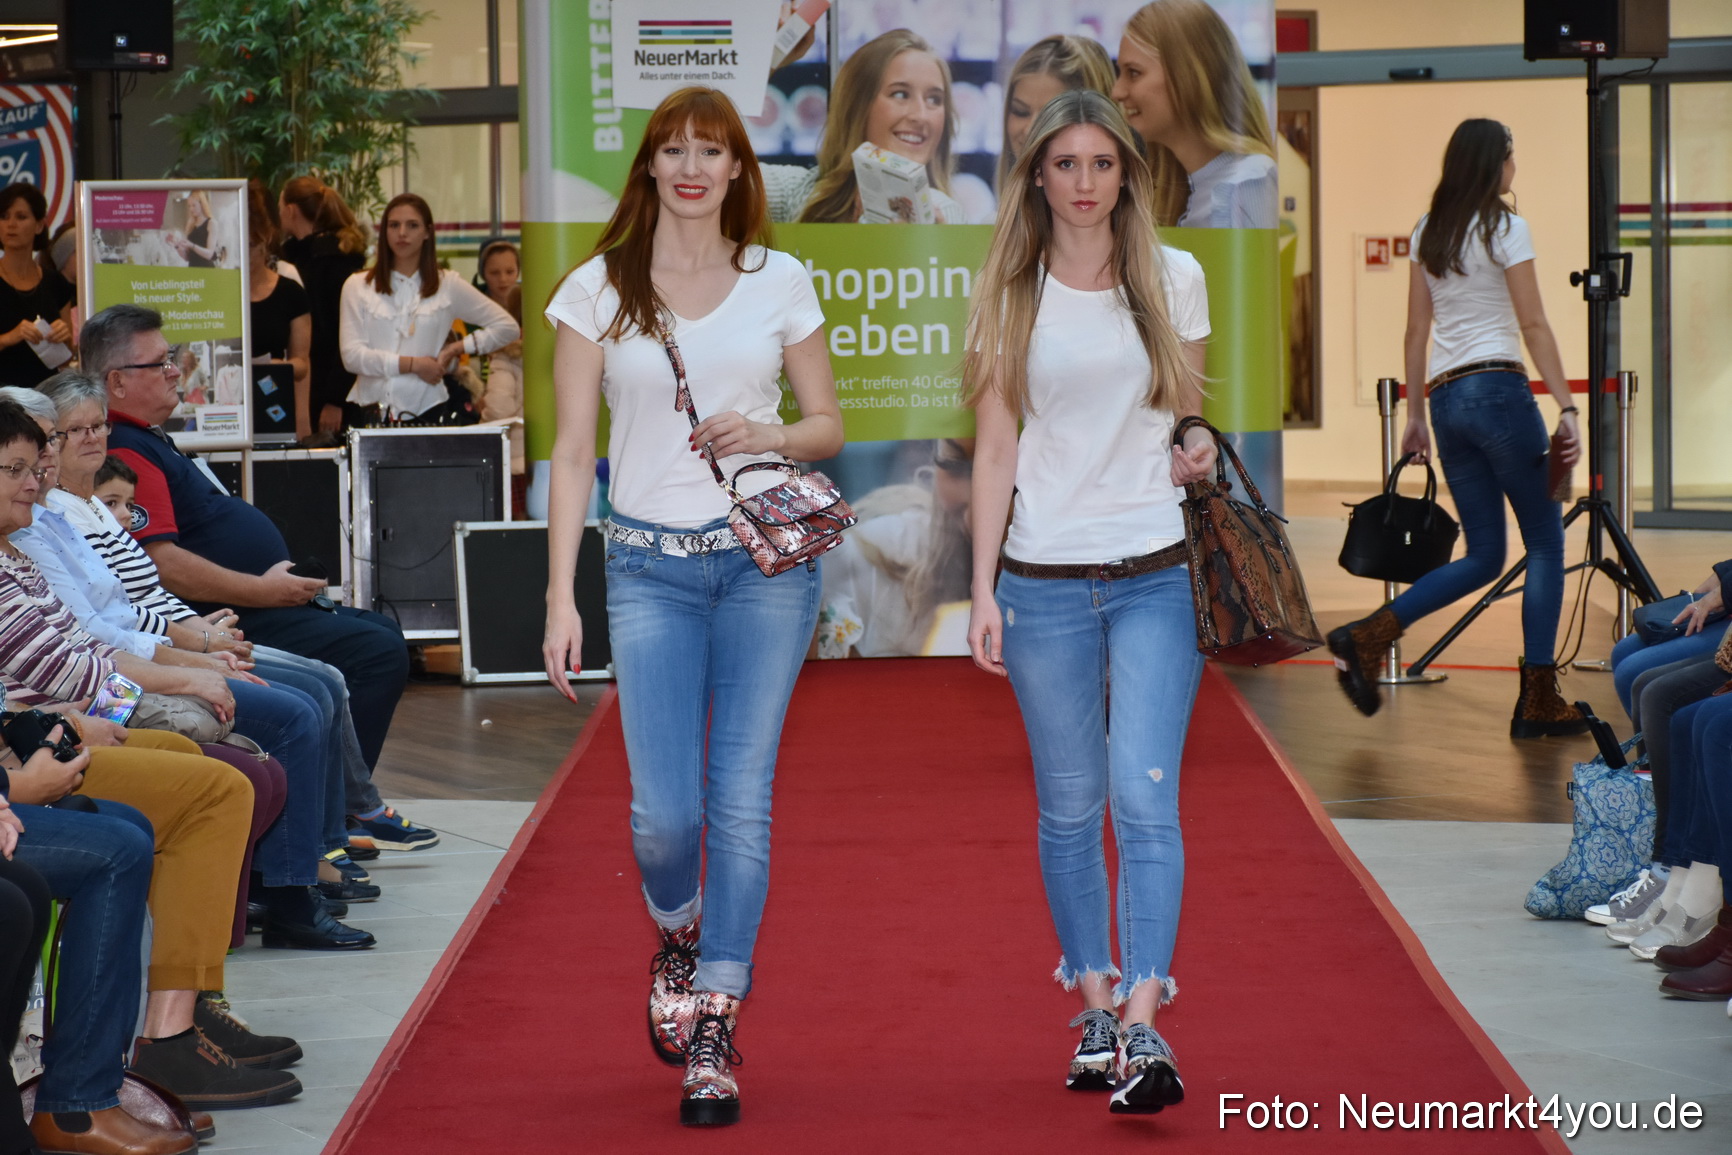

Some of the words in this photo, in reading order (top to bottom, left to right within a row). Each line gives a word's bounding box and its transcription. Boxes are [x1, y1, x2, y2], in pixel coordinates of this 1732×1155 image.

[1595, 42, 1606, 53] 12
[156, 55, 167, 65] 12
[634, 48, 739, 66] NeuerMarkt
[639, 71, 659, 80] Alles
[659, 72, 681, 80] unter
[683, 71, 710, 80] einem
[711, 71, 736, 80] Dach.
[131, 280, 148, 290] Von
[149, 279, 205, 291] Lieblingsteil
[804, 256, 971, 310] hoppin
[133, 293, 147, 303] bis
[149, 294, 175, 303] neuer
[176, 292, 202, 304] Style.
[829, 314, 950, 356] eben
[862, 375, 908, 390] treffen
[911, 375, 931, 389] 40
[839, 393, 909, 409] essstudio.
[911, 393, 928, 408] Da
[932, 392, 948, 407] ist
[202, 423, 240, 432] NeuerMarkt
